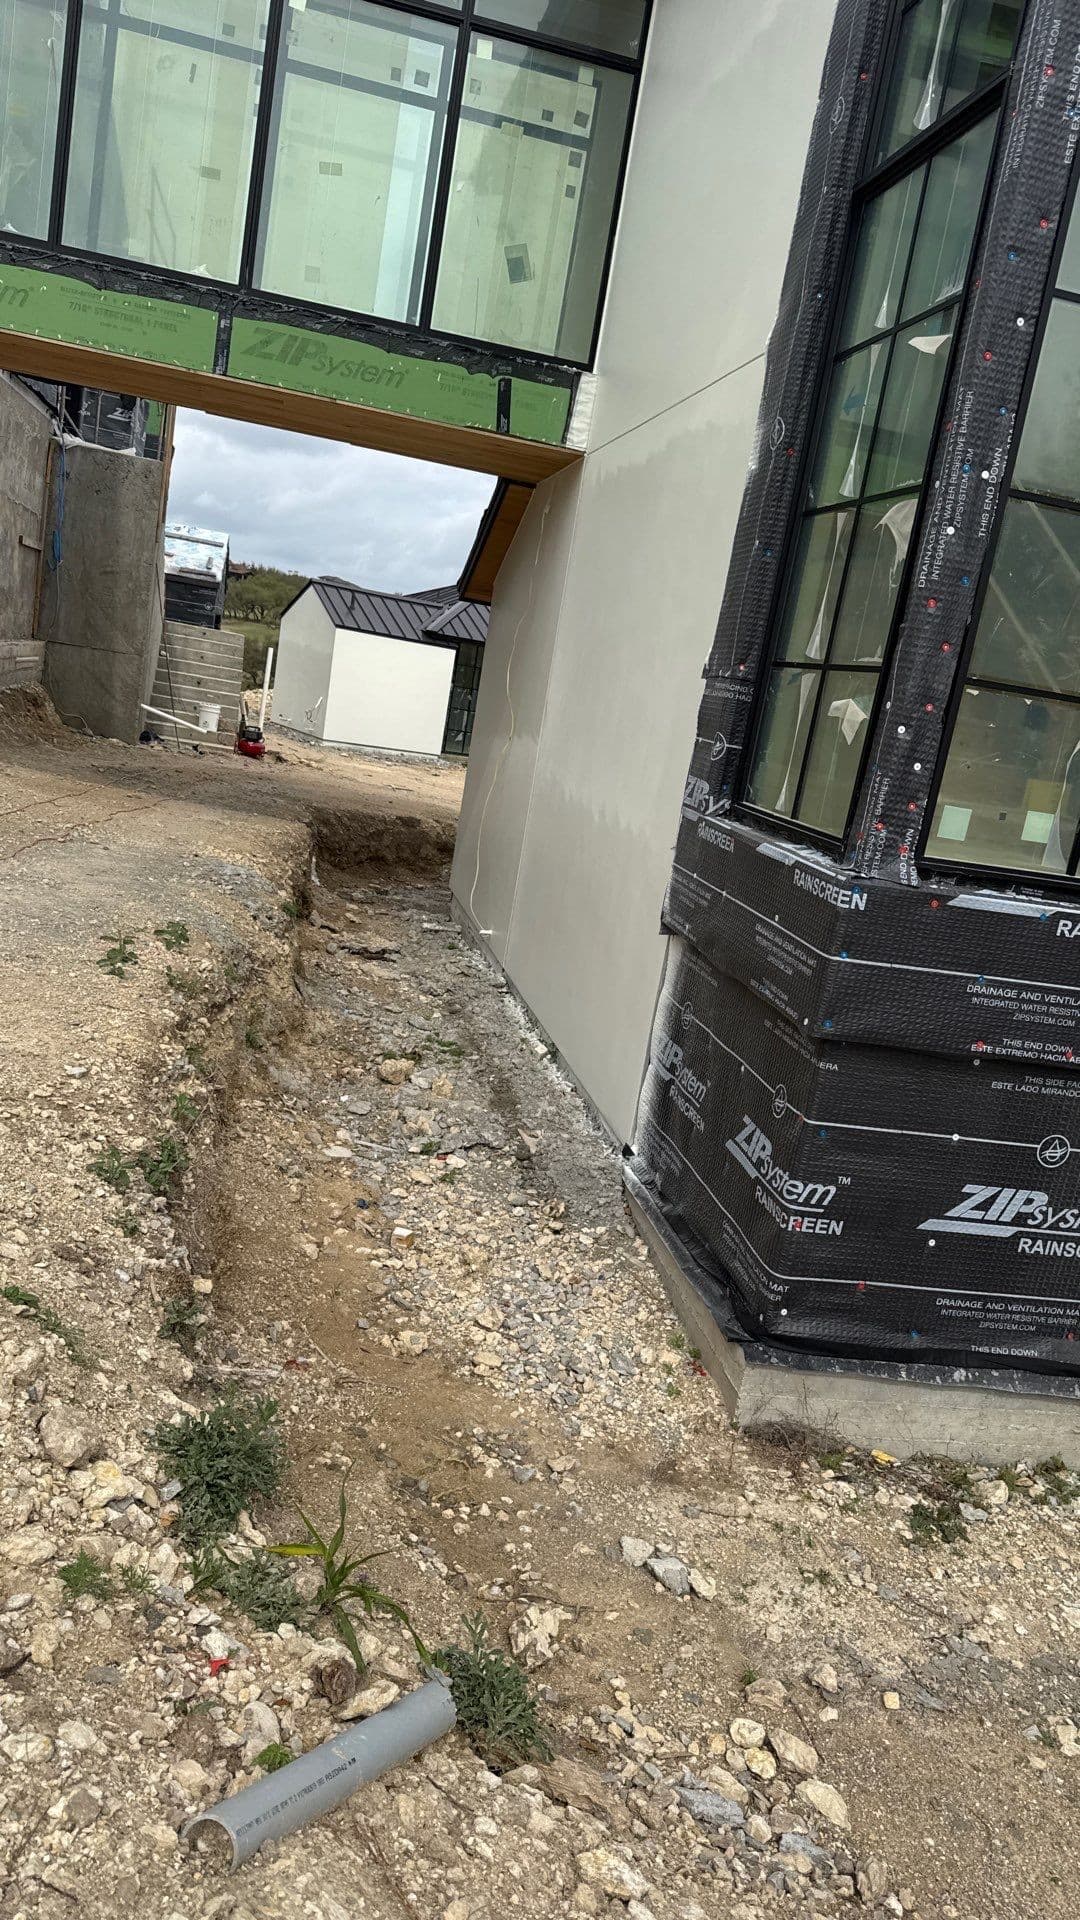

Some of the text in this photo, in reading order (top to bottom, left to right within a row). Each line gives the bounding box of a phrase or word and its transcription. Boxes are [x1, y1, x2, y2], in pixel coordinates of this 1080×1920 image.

[1069, 65, 1080, 91] END
[1064, 133, 1077, 164] ESTE
[943, 485, 955, 518] WATER
[950, 434, 966, 484] RESISTIVE
[978, 447, 1002, 537] THIS END DOWN
[793, 868, 868, 911] RAINSCREEN
[966, 984, 1018, 998] DRAINAGE
[1019, 991, 1042, 1001] AND
[971, 997, 1020, 1009] INTEGRATED
[1021, 1003, 1047, 1013] WATER
[1013, 1013, 1076, 1027] ZIPSYSTEM.COM
[1003, 1038, 1073, 1054] THIS END DOWN
[995, 1047, 1038, 1059] EXTREMO
[1040, 1052, 1067, 1062] HACIA
[991, 1081, 1014, 1090] ESTE
[1015, 1084, 1039, 1093] LADO
[1025, 1075, 1044, 1085] THIS
[1045, 1078, 1065, 1087] SIDE
[755, 1185, 844, 1236] RAINSCREEN
[935, 1298, 983, 1309] DRAINAGE
[984, 1302, 1005, 1310] AND
[1007, 1303, 1064, 1315] VENTILATION
[940, 1309, 985, 1318] INTEGRATED
[986, 1312, 1010, 1320] WATER
[1011, 1314, 1047, 1323] RESISTIVE
[971, 1345, 1038, 1357] THIS END DOWN
